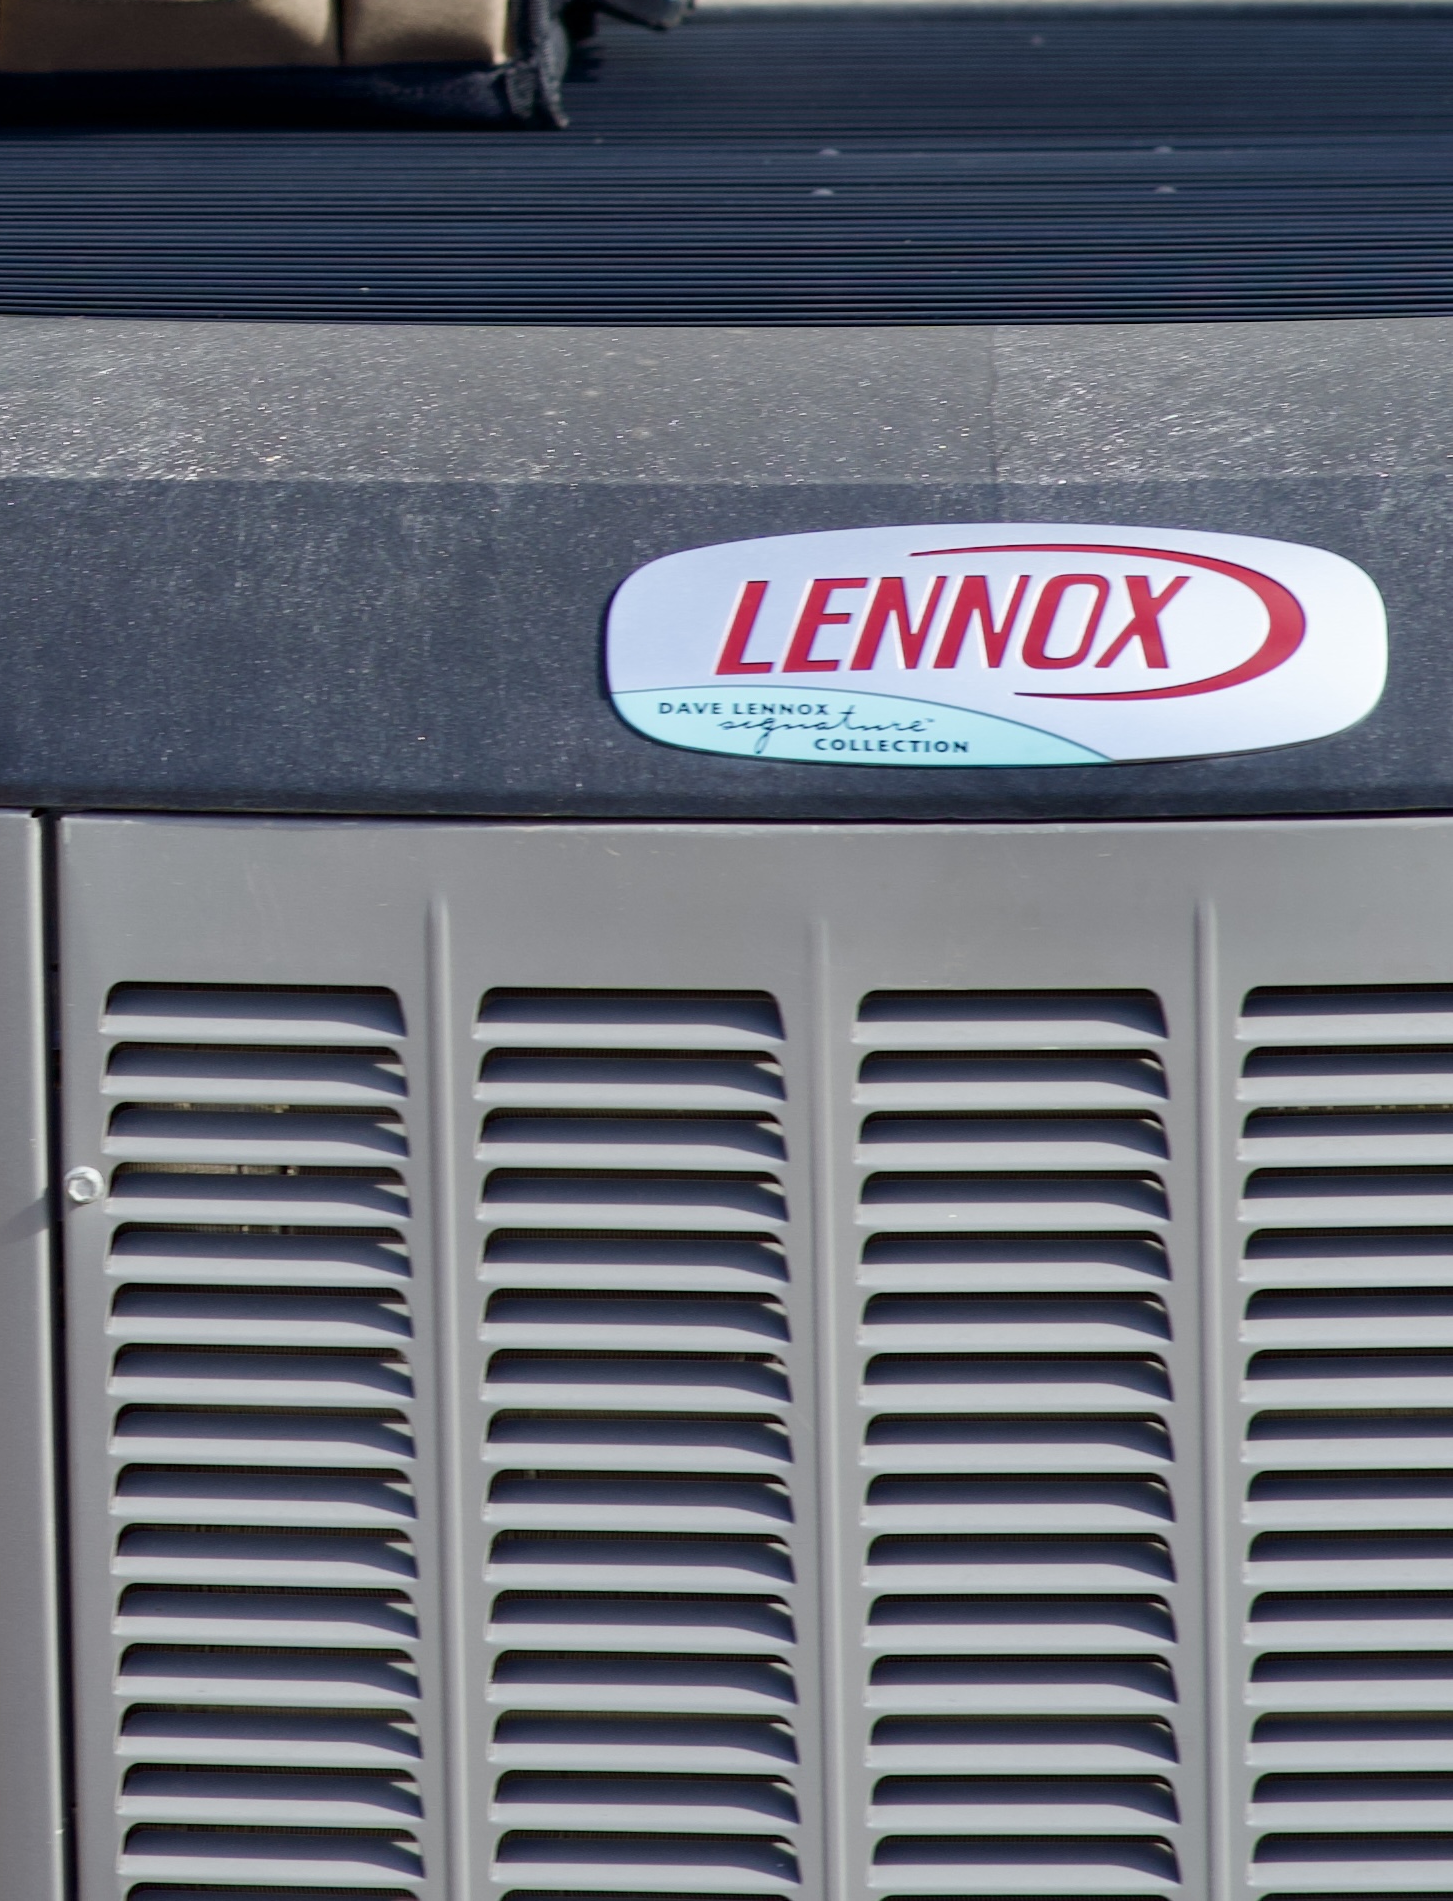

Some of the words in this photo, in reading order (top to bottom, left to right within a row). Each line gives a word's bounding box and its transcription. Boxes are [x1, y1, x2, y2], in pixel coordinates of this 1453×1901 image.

[715, 574, 1192, 675] LENNOX
[658, 701, 723, 716] DAVE
[731, 701, 831, 716] LENNOX
[813, 737, 970, 754] COLLECTION
